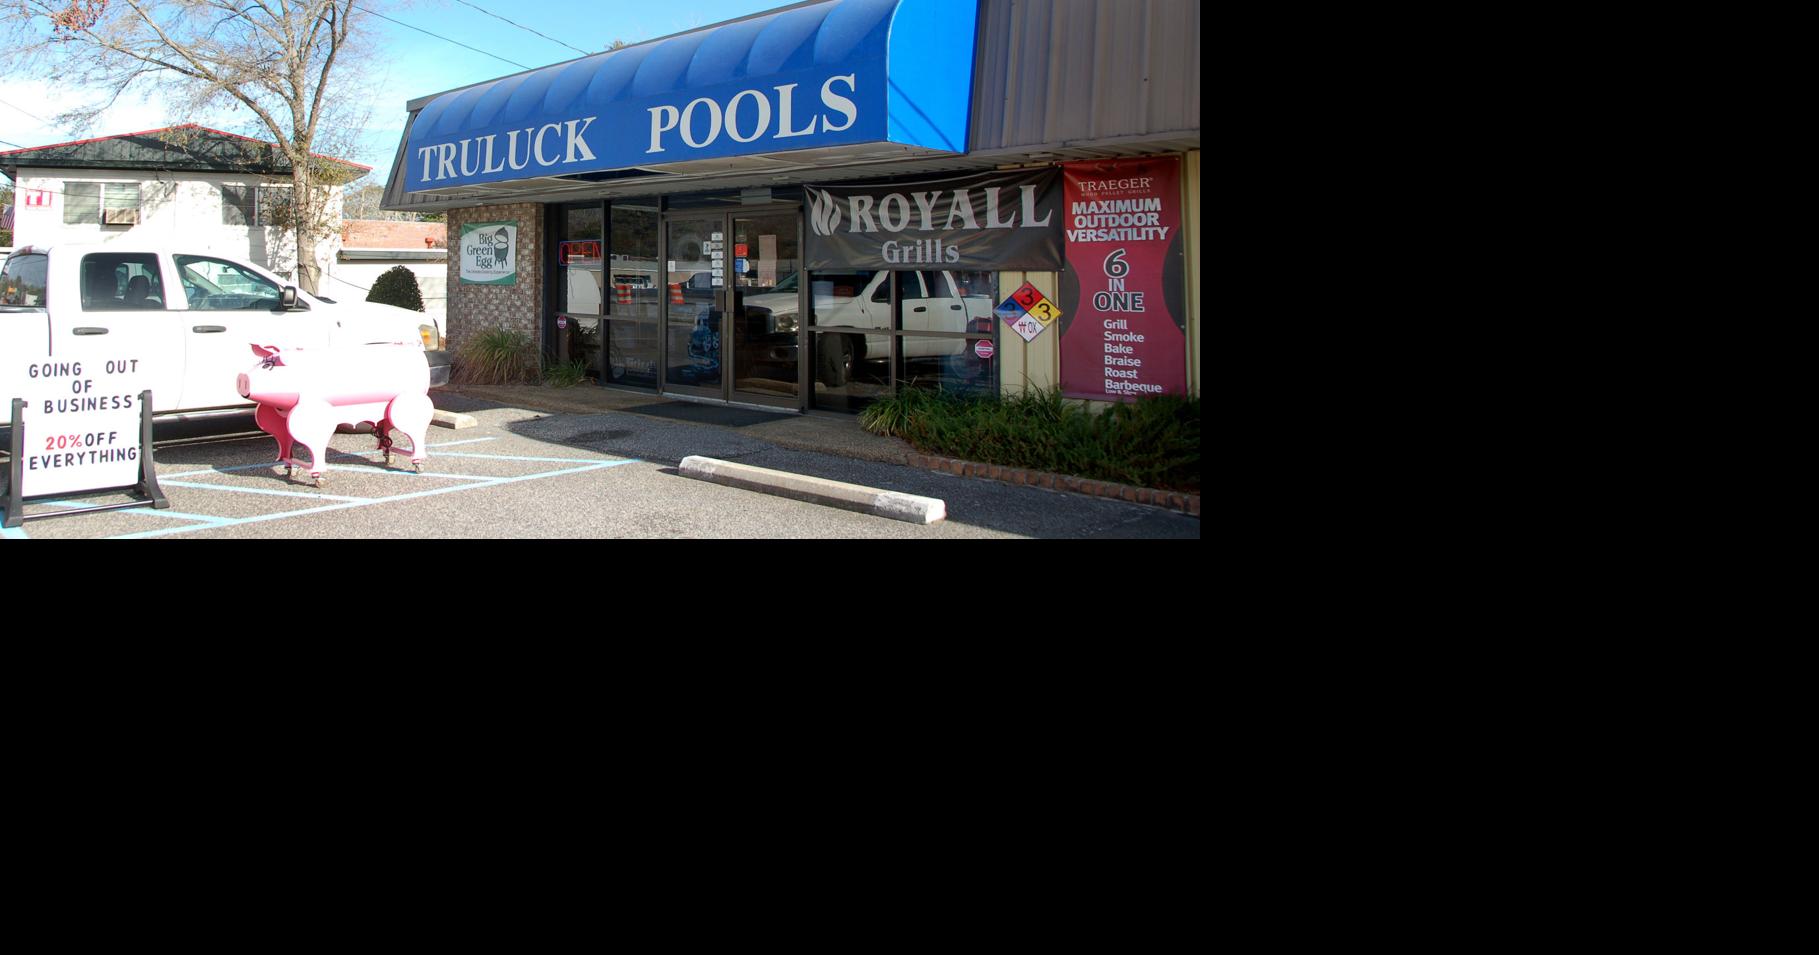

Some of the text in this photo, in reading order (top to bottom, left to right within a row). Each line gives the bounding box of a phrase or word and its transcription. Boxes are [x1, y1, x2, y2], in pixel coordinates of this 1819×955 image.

[418, 73, 858, 182] TRULUCK POOLS
[848, 184, 1053, 233] ROYALL
[1072, 198, 1162, 215] MAXIMUM
[1074, 213, 1160, 228] OUTDOOR
[479, 233, 493, 246] Big
[1066, 226, 1169, 242] VERSATILITY
[466, 245, 493, 256] Green
[881, 239, 960, 264] Grills
[476, 256, 493, 269] Egg
[1103, 248, 1130, 279] 6
[1108, 278, 1125, 292] IN
[1021, 287, 1034, 306] 3
[1092, 291, 1145, 313] ONE
[1038, 303, 1051, 321] 3
[1103, 319, 1128, 330] Grill
[1103, 331, 1145, 342] Smoke
[1104, 343, 1134, 354] Bake
[1104, 355, 1142, 367] Braise
[29, 359, 138, 379] GOING OUT
[1104, 367, 1138, 379] Roast
[72, 379, 92, 394] OF
[1105, 379, 1163, 393] Barbeque
[44, 394, 133, 414] BUSINESS
[29, 447, 138, 471] EVERYTHING
